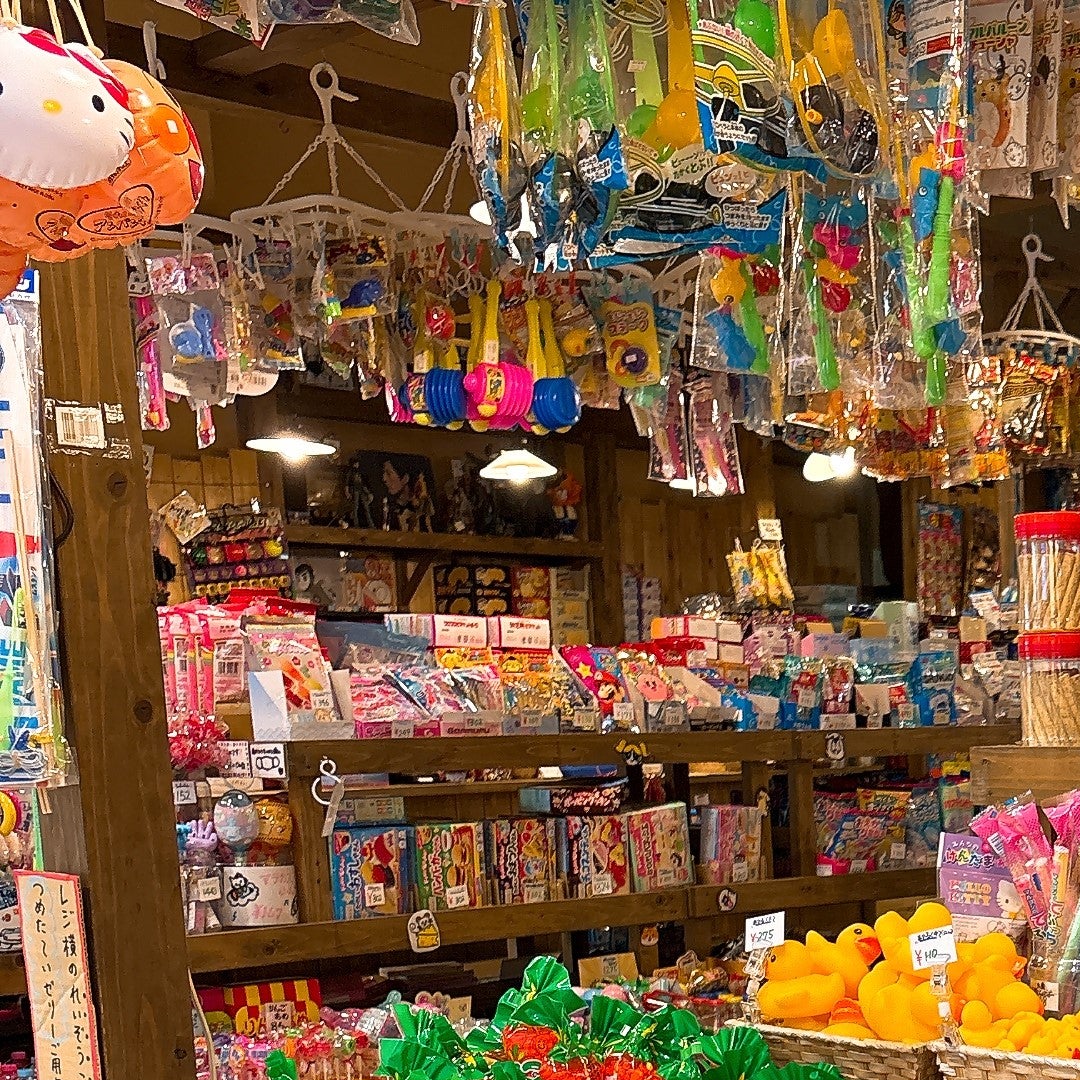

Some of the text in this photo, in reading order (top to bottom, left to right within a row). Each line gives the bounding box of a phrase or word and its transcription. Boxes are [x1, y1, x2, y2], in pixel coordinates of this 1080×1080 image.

[943, 850, 994, 868] けんだま
[949, 879, 992, 894] HELLO
[949, 892, 992, 906] KITTY
